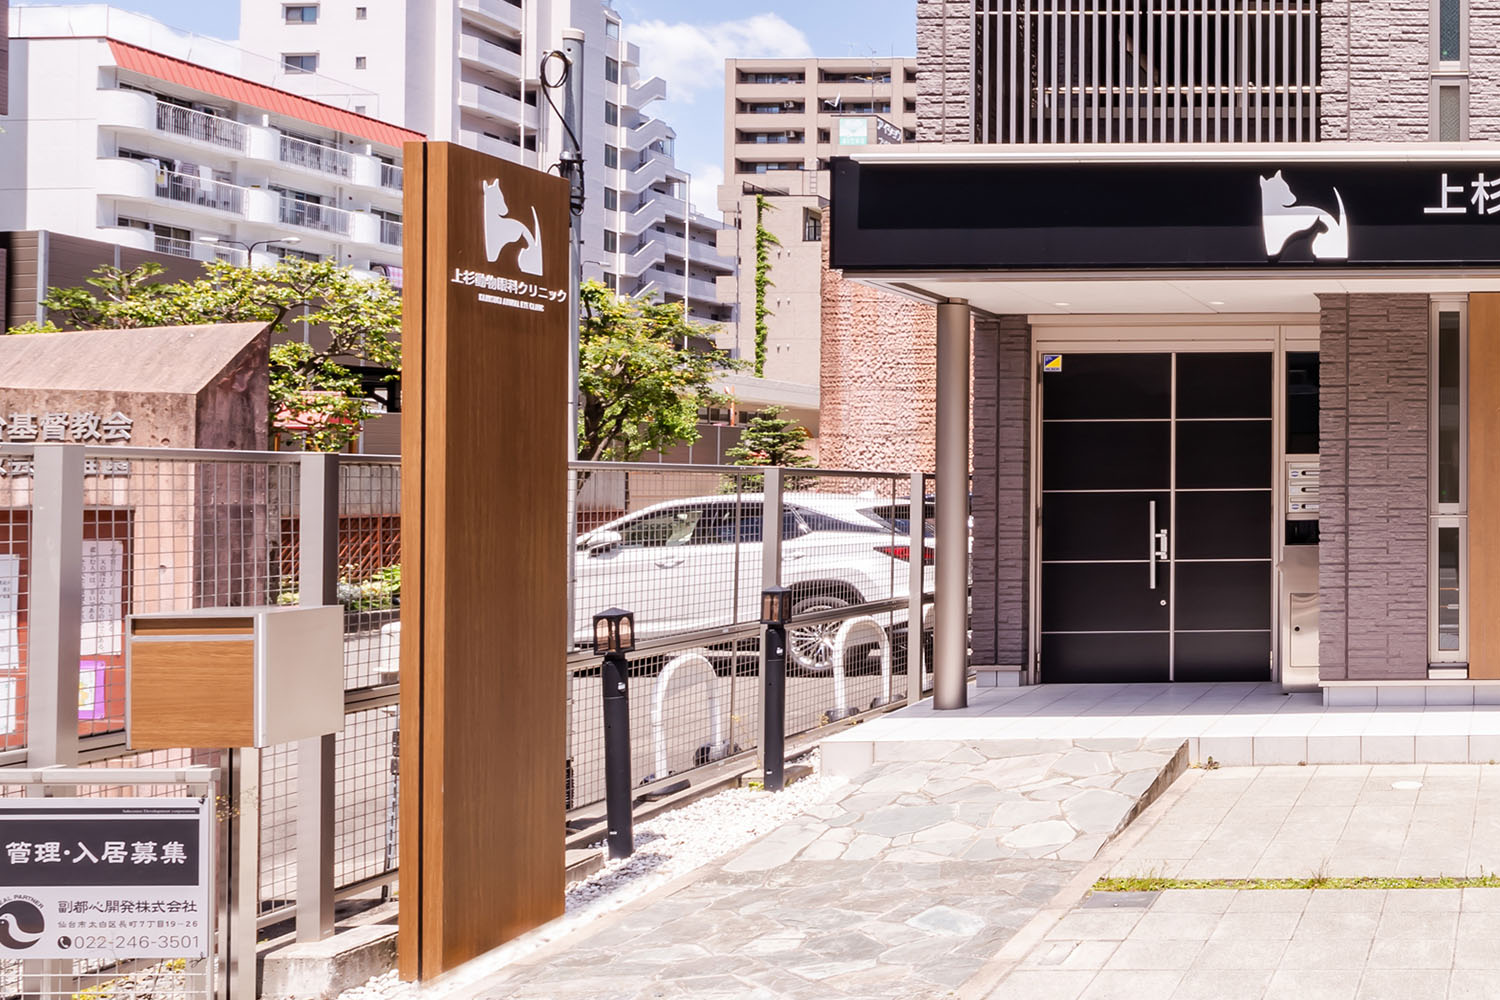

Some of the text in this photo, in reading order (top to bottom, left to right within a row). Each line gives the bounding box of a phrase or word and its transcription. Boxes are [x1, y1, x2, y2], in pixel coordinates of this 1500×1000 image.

[451, 268, 567, 302] 上杉動物眼科クリニック
[0, 411, 134, 441] 基督教会
[5, 841, 188, 865] 管理・入居募集
[58, 900, 198, 914] 副都心開発株式会社
[74, 935, 199, 949] 022-246-3501
